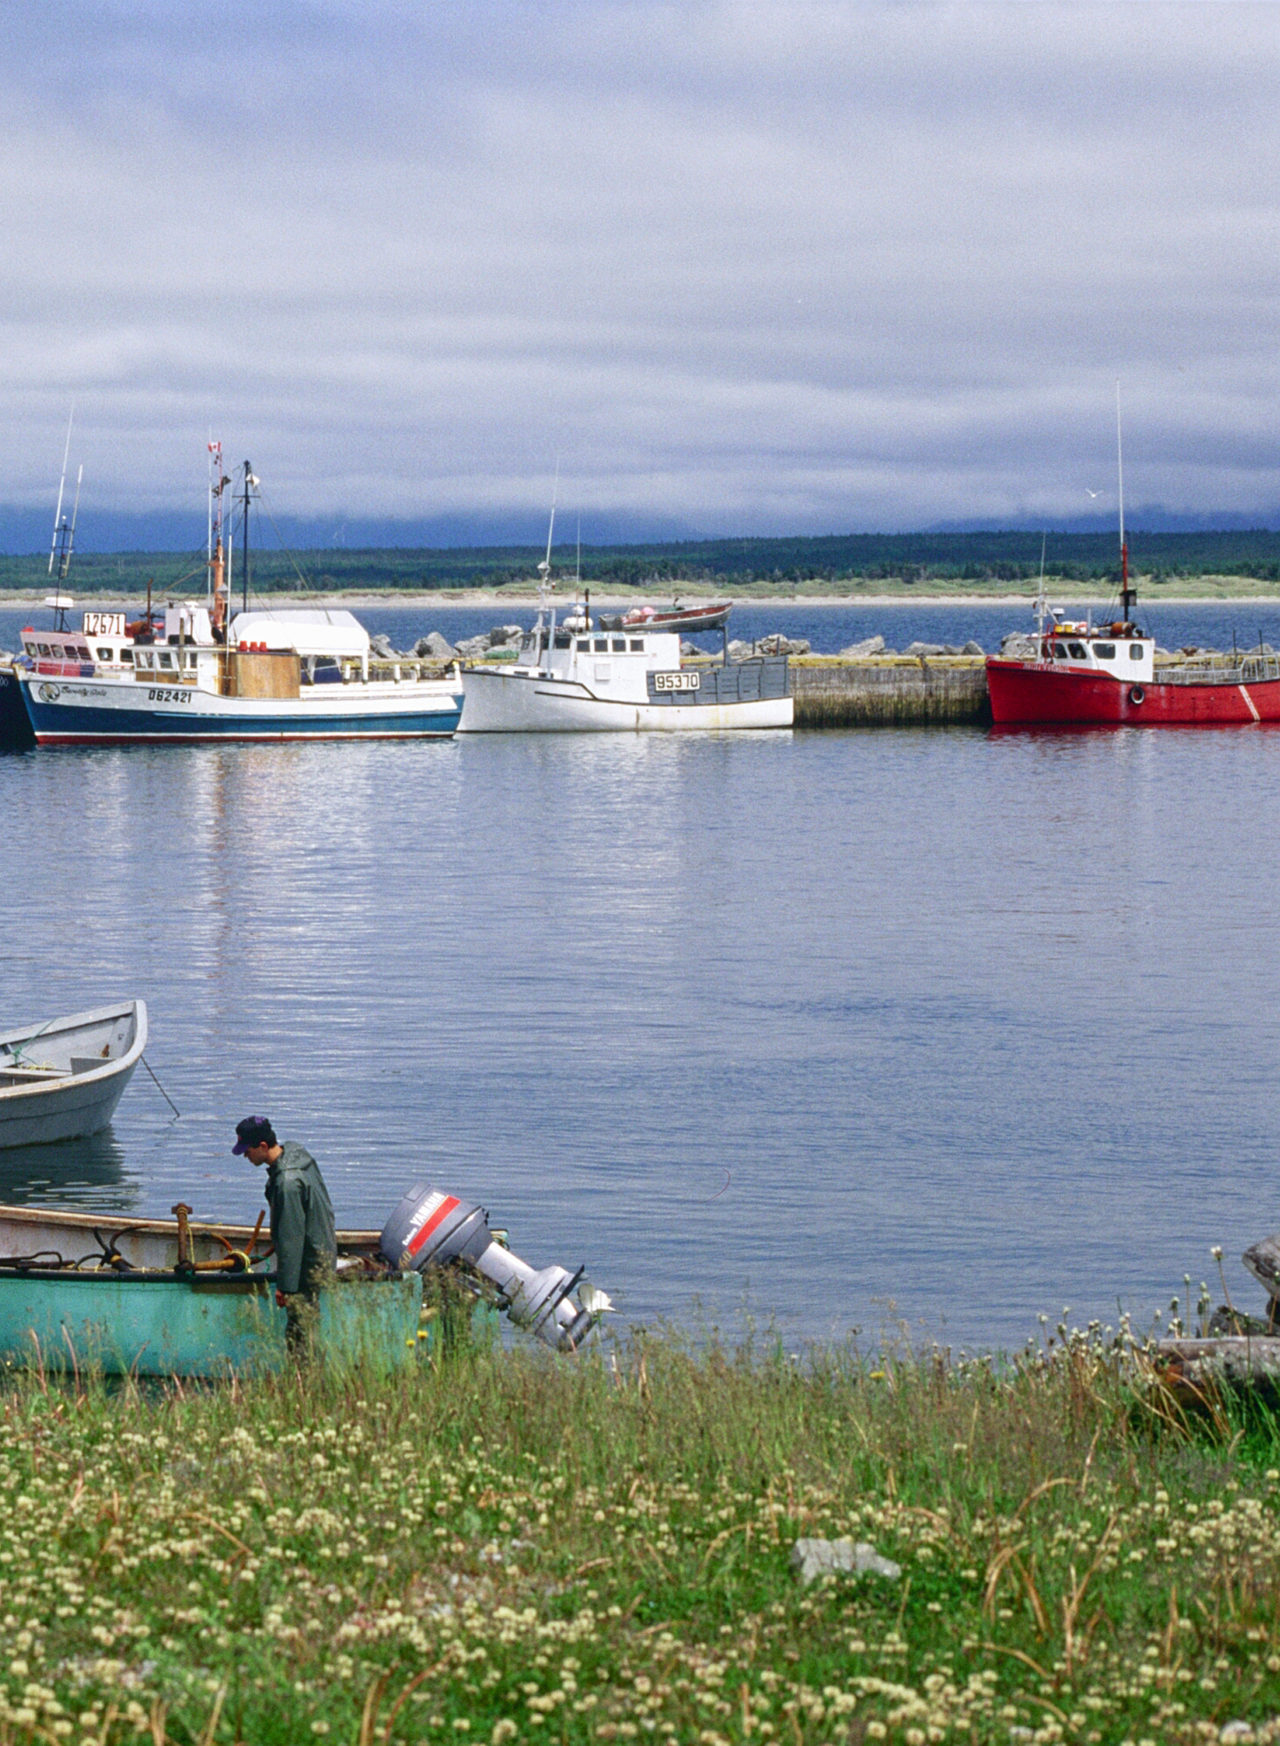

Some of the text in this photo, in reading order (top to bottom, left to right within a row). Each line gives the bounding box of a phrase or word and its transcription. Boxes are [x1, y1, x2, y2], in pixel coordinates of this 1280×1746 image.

[85, 613, 122, 635] 12671
[656, 673, 699, 689] 95370
[147, 688, 193, 704] 062421
[409, 1191, 446, 1228] YAMAHA
